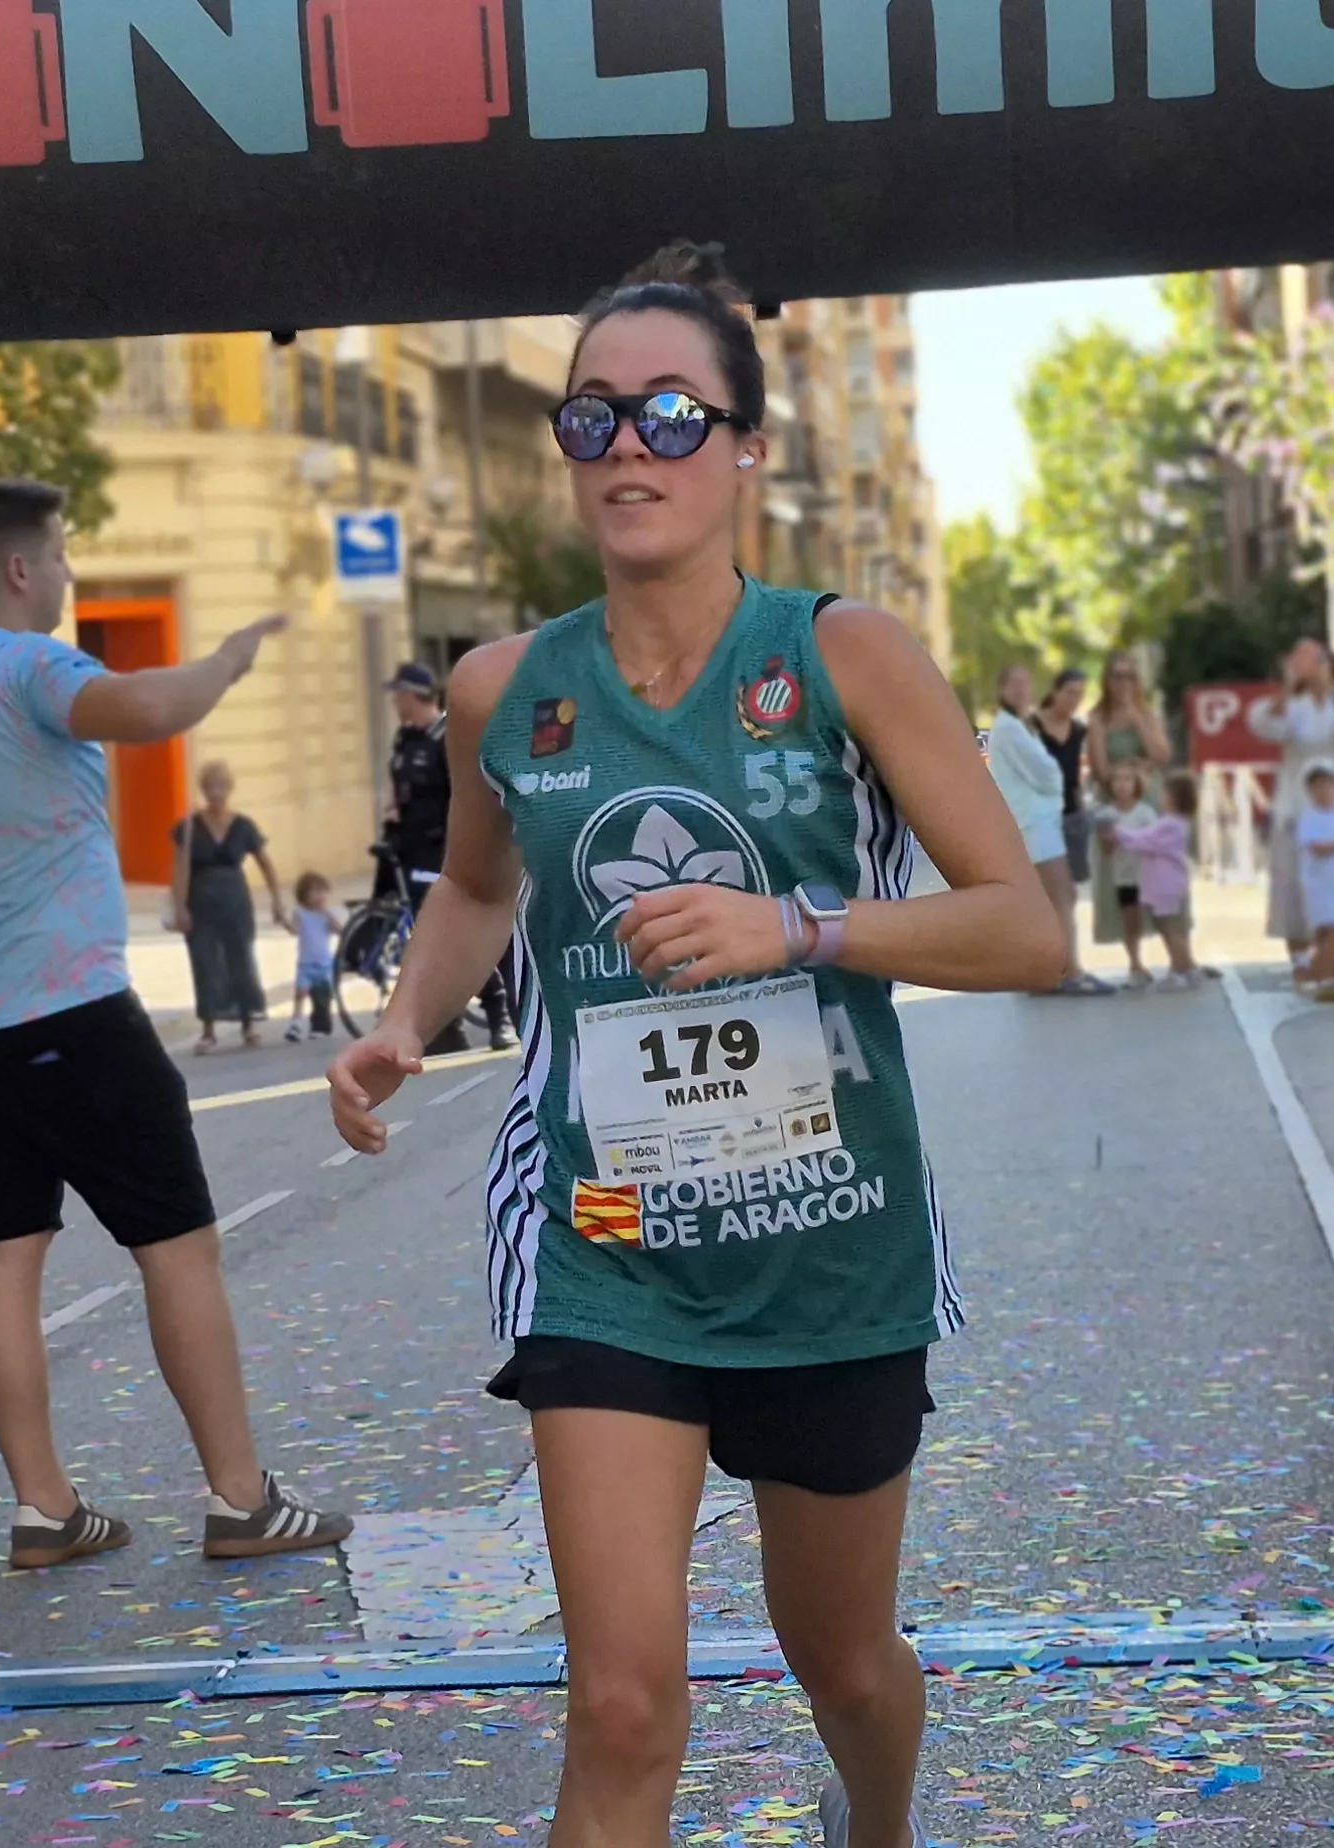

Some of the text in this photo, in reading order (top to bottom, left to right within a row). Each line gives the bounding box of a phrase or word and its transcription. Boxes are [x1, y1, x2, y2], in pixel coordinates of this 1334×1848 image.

[745, 750, 822, 819] 55
[638, 1017, 761, 1083] 179
[665, 1079, 749, 1108] MARTA
[643, 1147, 856, 1214] GOBIERNO
[643, 1175, 886, 1250] DE ARAGON
